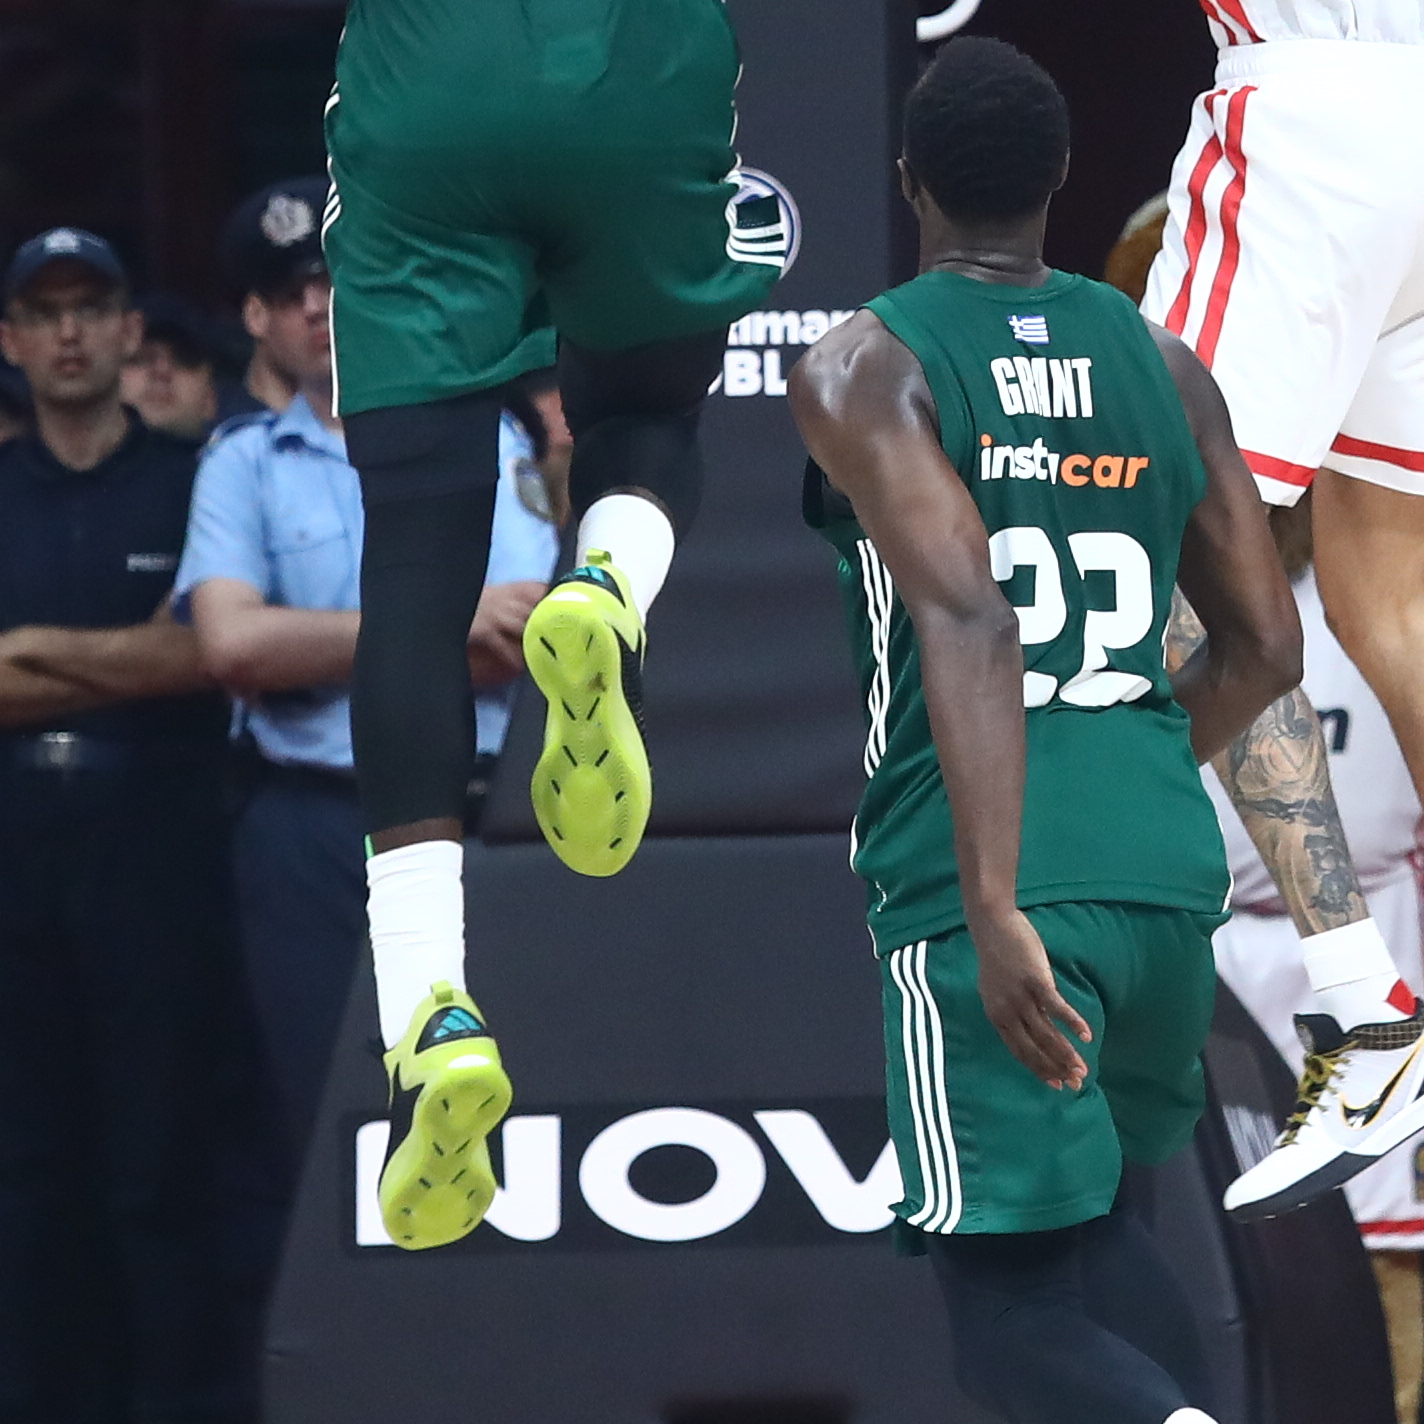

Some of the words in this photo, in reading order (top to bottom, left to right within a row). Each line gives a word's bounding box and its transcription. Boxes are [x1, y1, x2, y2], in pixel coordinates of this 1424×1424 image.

[707, 348, 788, 397] BL
[990, 356, 1094, 418] GRANT
[988, 526, 1153, 708] 22
